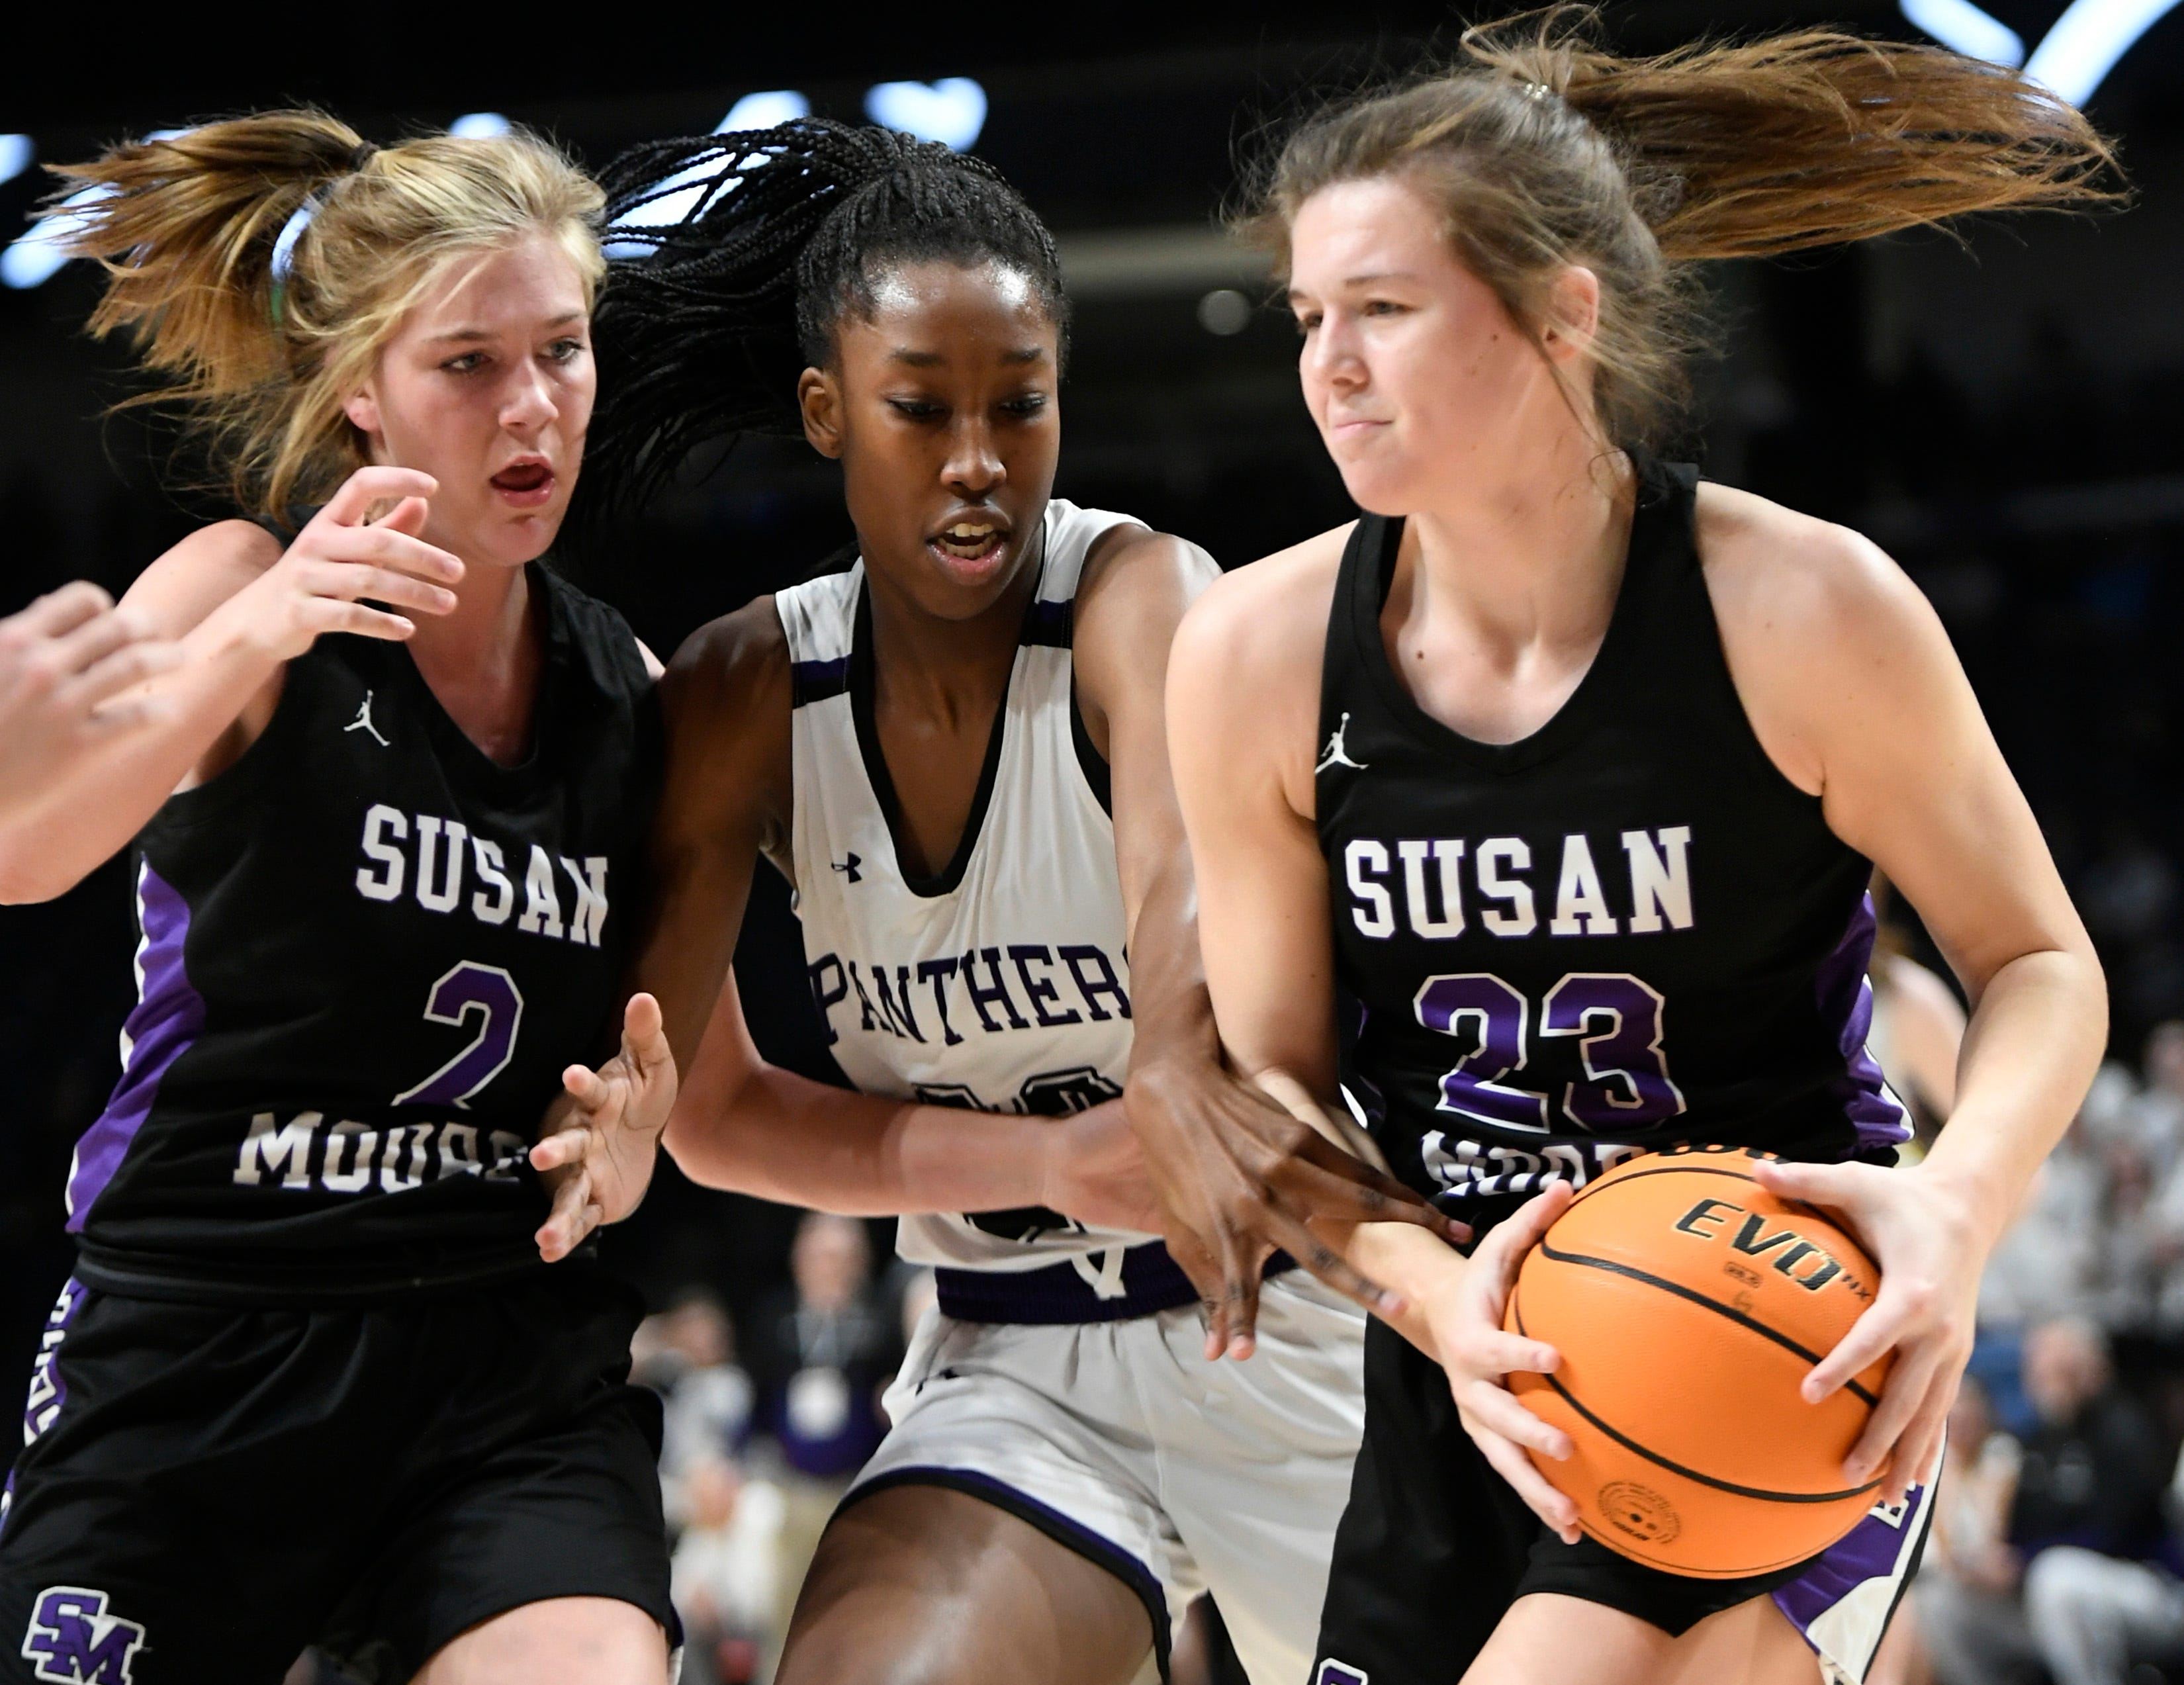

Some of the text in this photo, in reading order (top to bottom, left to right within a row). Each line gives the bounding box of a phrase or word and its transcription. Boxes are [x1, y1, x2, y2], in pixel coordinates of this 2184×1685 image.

[355, 803, 610, 948] SUSAN
[1344, 825, 1695, 940] SUSAN
[390, 958, 524, 1109] 2
[806, 944, 1134, 1046] PANTHER
[1412, 972, 1688, 1134] 23
[1673, 1197, 1843, 1293] EVO
